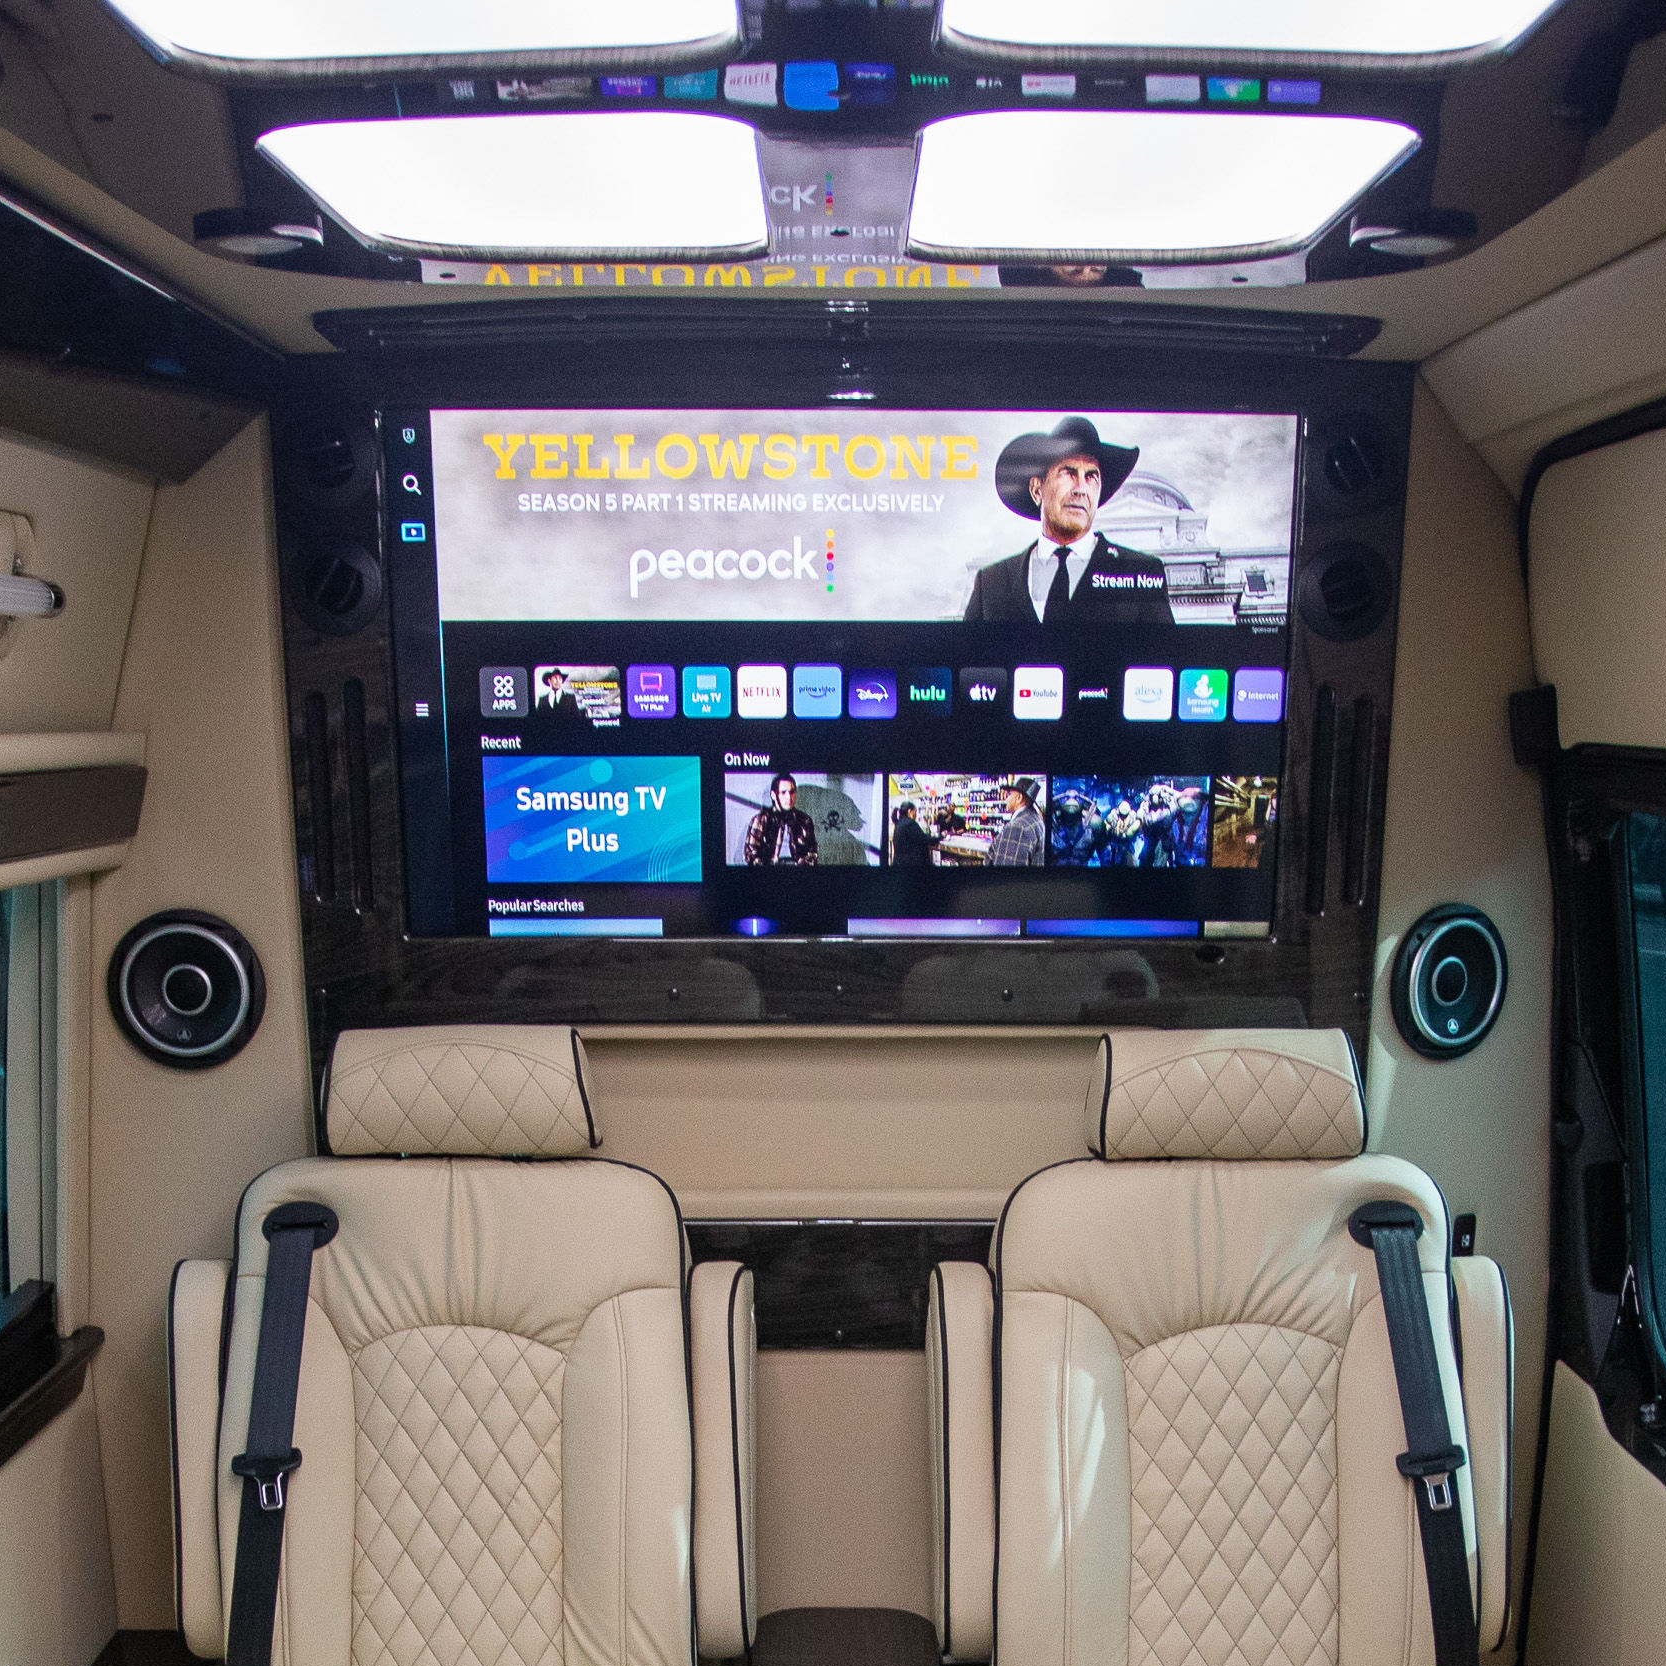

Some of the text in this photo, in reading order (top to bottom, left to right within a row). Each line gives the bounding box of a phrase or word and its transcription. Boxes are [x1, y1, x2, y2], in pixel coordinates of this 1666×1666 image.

[483, 433, 979, 480] YELLOWSTONE
[517, 493, 945, 513] SEASON 5 PART 1 STREAMING EXCLUSIVELY
[629, 535, 820, 599] peacock
[1091, 574, 1164, 589] Stream Now
[742, 687, 781, 698] NETFLIX
[798, 685, 817, 695] prime
[910, 685, 946, 701] hulu
[1032, 689, 1058, 698] YouTube
[1134, 686, 1163, 697] alexa
[1248, 690, 1280, 702] Internet
[633, 694, 669, 703] SAMSUNG
[691, 693, 722, 703] Live TV
[1187, 698, 1219, 708] Samsung
[492, 699, 517, 711] APPS
[640, 703, 664, 712] TV Plus
[701, 704, 712, 713] Air
[480, 736, 522, 749] Recent
[724, 752, 770, 766] On Now
[516, 786, 667, 816] Samsung TV
[566, 828, 620, 852] Plus
[487, 899, 585, 914] Popular Searches
